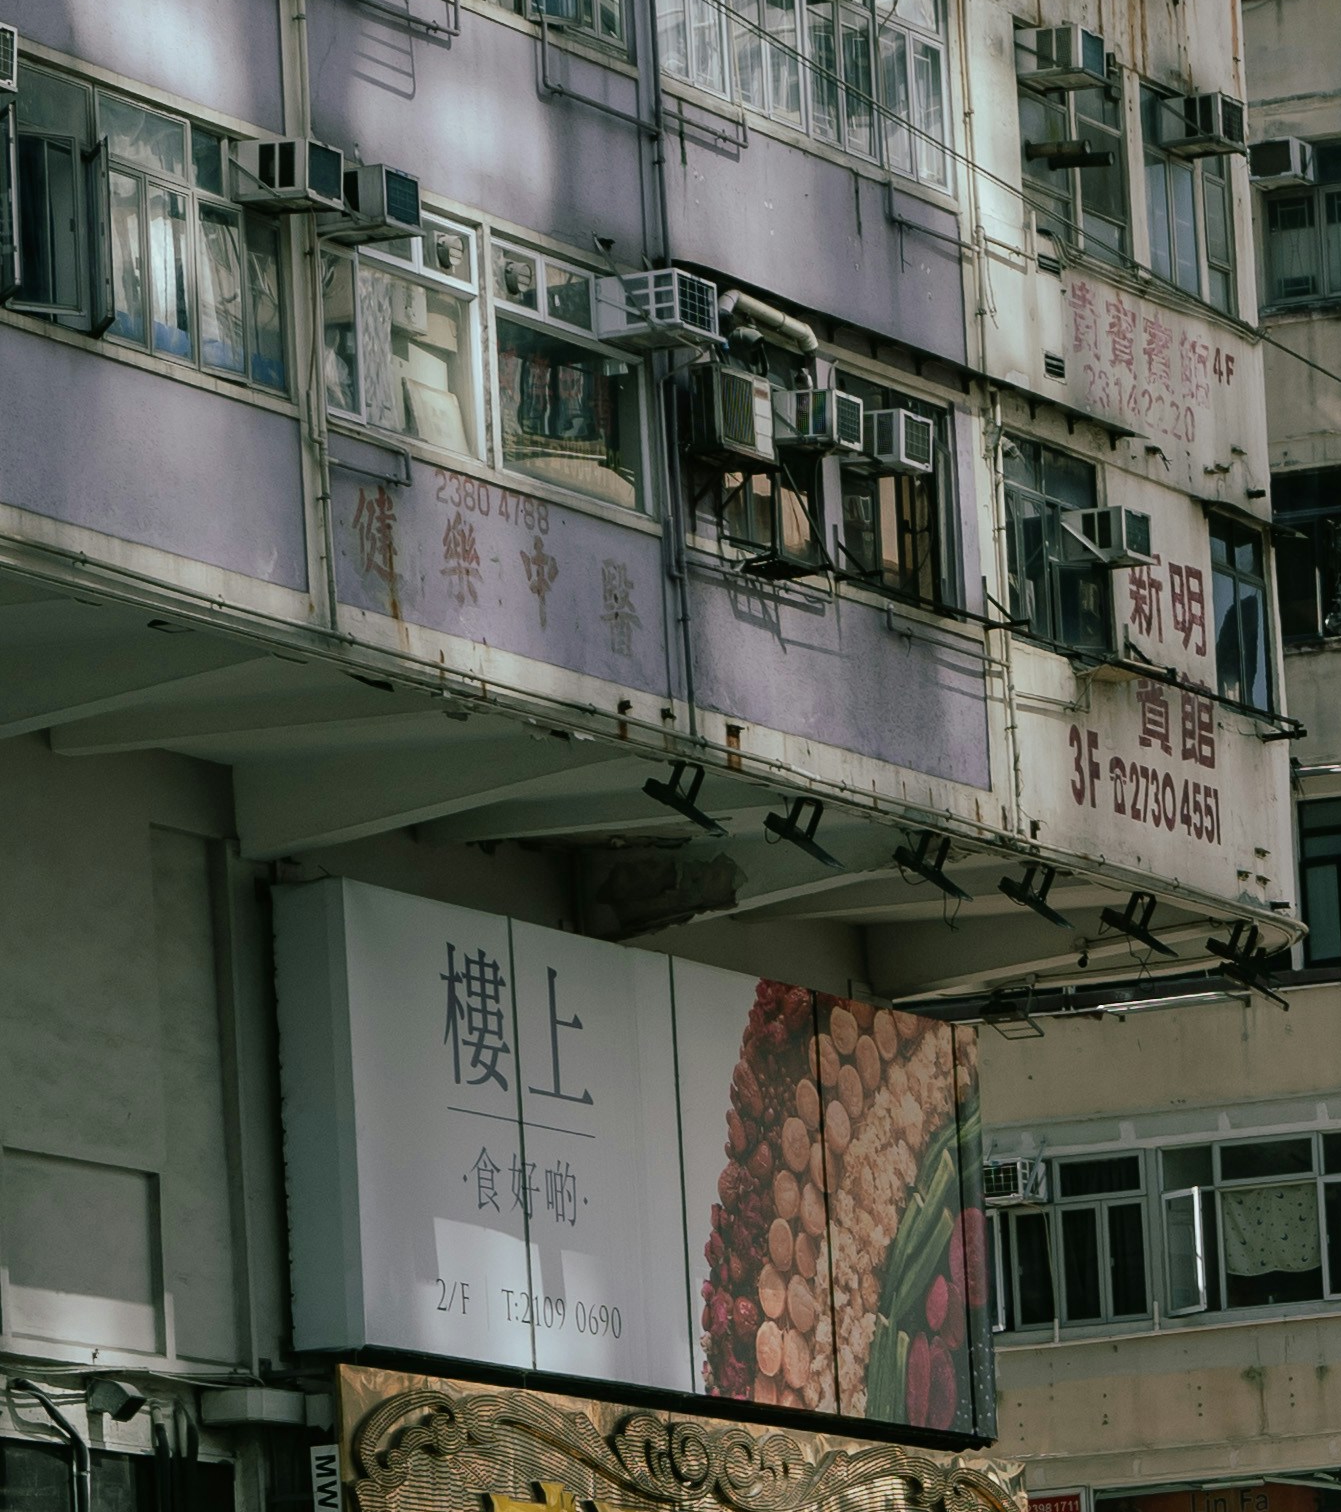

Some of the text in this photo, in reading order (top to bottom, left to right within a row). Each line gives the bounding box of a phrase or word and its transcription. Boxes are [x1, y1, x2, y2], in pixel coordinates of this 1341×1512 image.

[1213, 347, 1236, 386] 4F
[1069, 724, 1101, 809] 3F
[440, 941, 594, 1106] 樓上
[435, 1277, 471, 1315] 2/F
[576, 1301, 622, 1340] 0690
[1240, 1490, 1269, 1512] Fa
